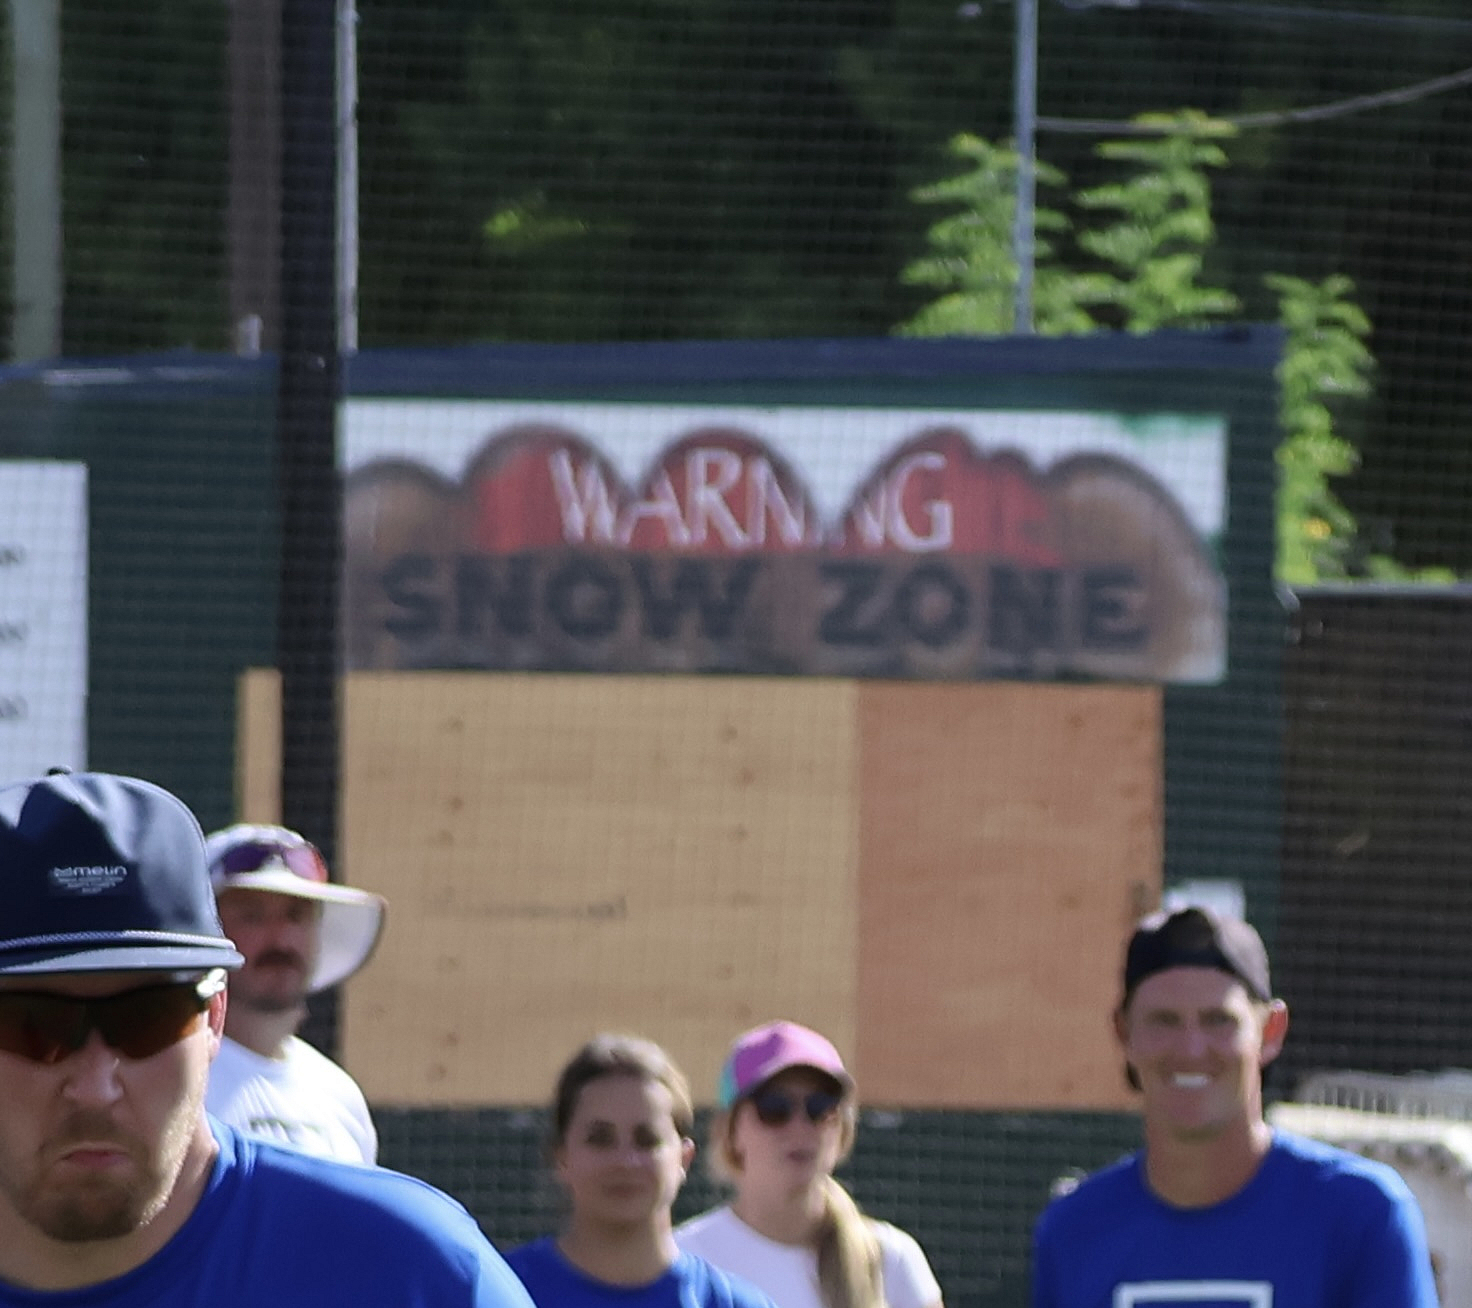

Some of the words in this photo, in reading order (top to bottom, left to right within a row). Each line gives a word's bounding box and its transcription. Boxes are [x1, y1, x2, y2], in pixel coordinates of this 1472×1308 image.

[548, 447, 954, 552] WARNNG
[382, 559, 761, 645] SNOW
[816, 563, 1149, 649] ZONE
